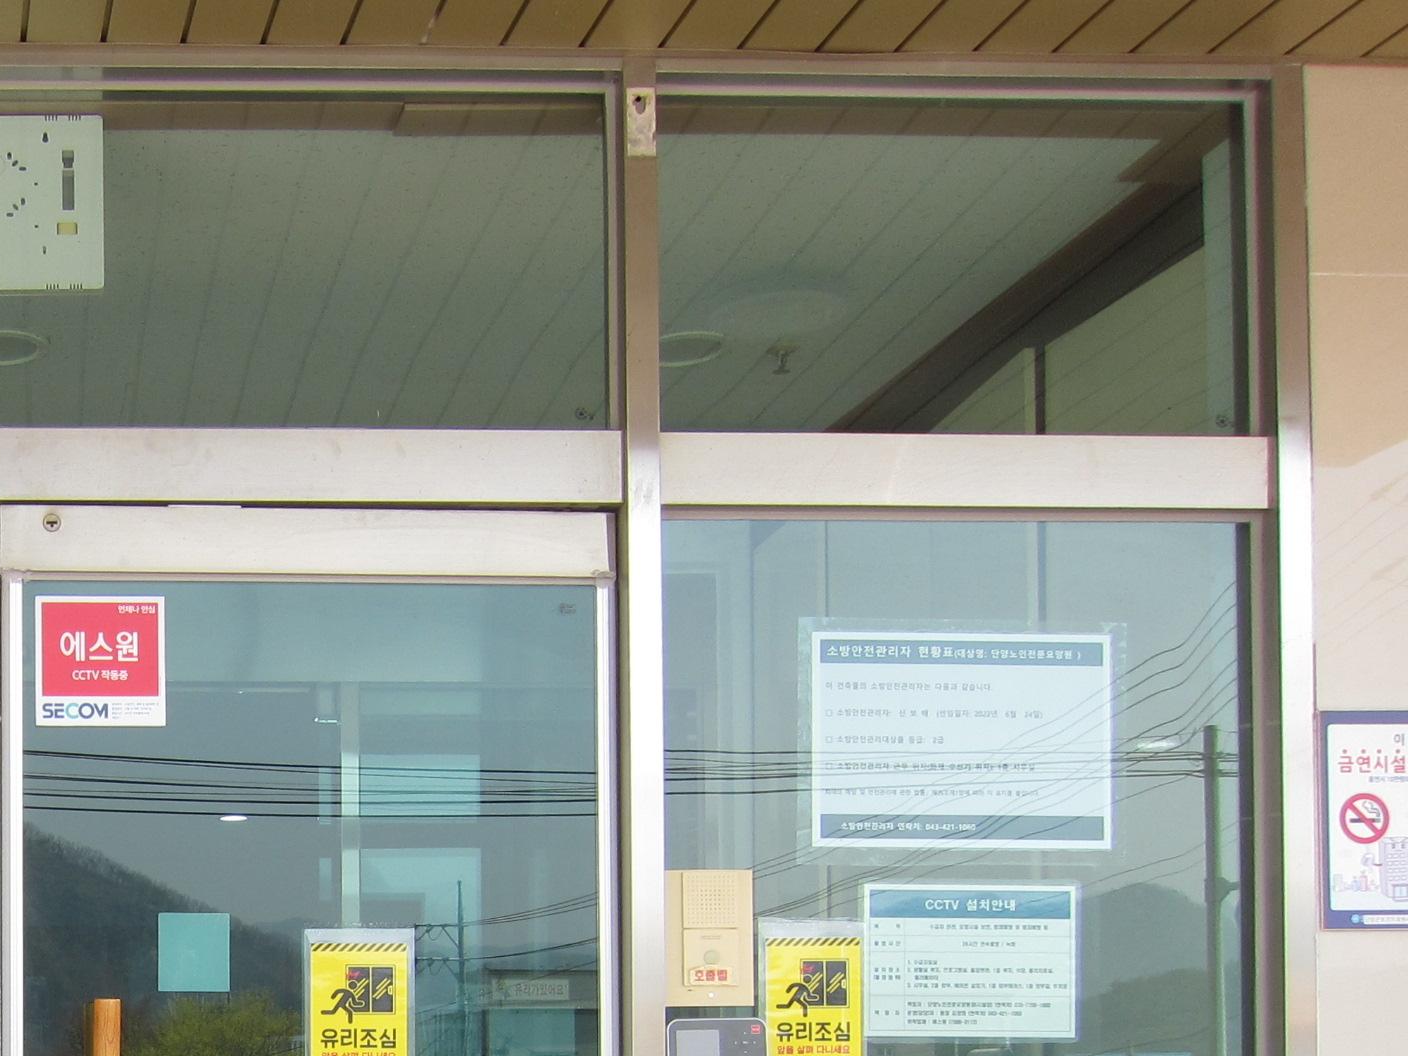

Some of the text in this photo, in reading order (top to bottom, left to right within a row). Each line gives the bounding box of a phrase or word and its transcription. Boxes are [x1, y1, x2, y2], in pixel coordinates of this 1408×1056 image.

[118, 605, 156, 614] 언제나 안심
[60, 631, 139, 662] 에스원
[826, 644, 911, 658] 소방안전관리자
[72, 670, 129, 681] CCTV 작동중
[42, 702, 109, 719] SECOM
[1393, 733, 1405, 746] 이
[1337, 755, 1406, 774] 금연시설
[924, 899, 1017, 912] CCTV 설치안내
[320, 1028, 397, 1049] 유리조심
[776, 1021, 851, 1042] 유리조심
[816, 1045, 851, 1055] 다니세요
